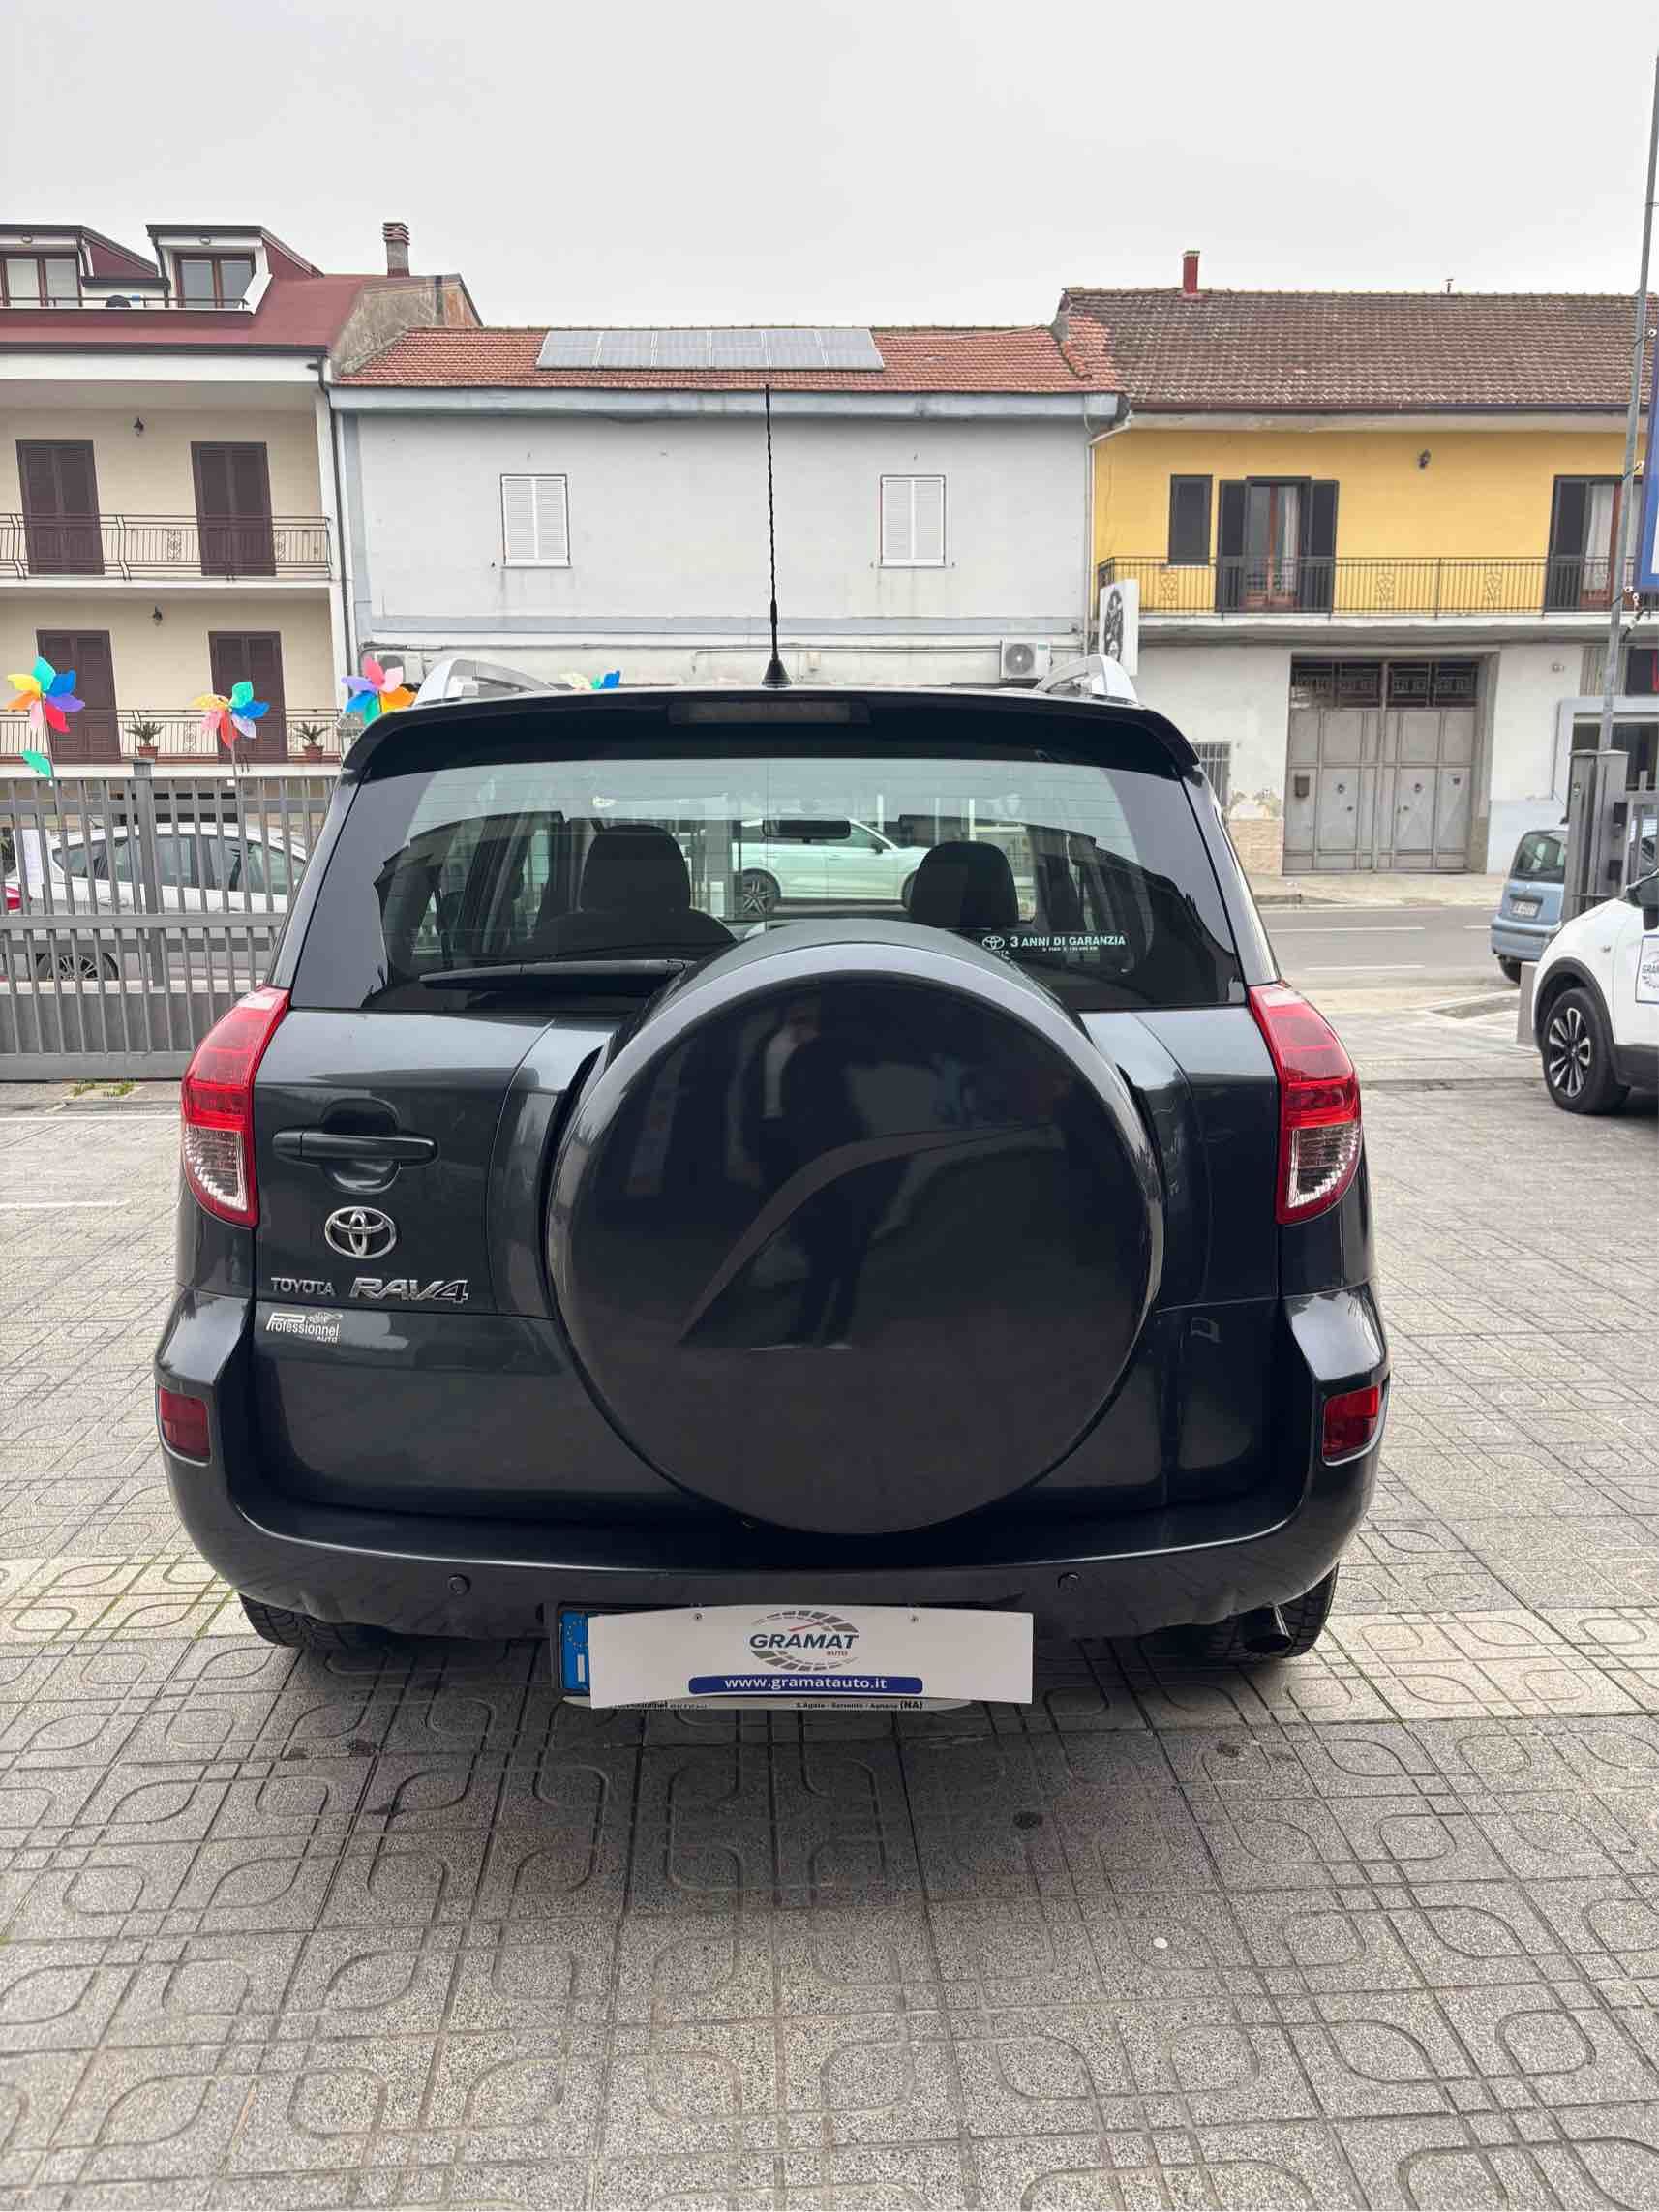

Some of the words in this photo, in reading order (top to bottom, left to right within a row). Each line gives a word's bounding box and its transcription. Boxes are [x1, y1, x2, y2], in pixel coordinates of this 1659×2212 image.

[1010, 935, 1019, 948] 3
[1021, 936, 1050, 946] ANNI
[1053, 936, 1066, 946] DI
[1068, 935, 1126, 946] GARANZIA
[270, 1277, 336, 1296] TOYOTA
[349, 1277, 470, 1303] RAV4
[266, 1312, 340, 1337] Professionnel
[749, 1633, 859, 1649] GRAMAT
[724, 1677, 887, 1690] www.gramatauto.it
